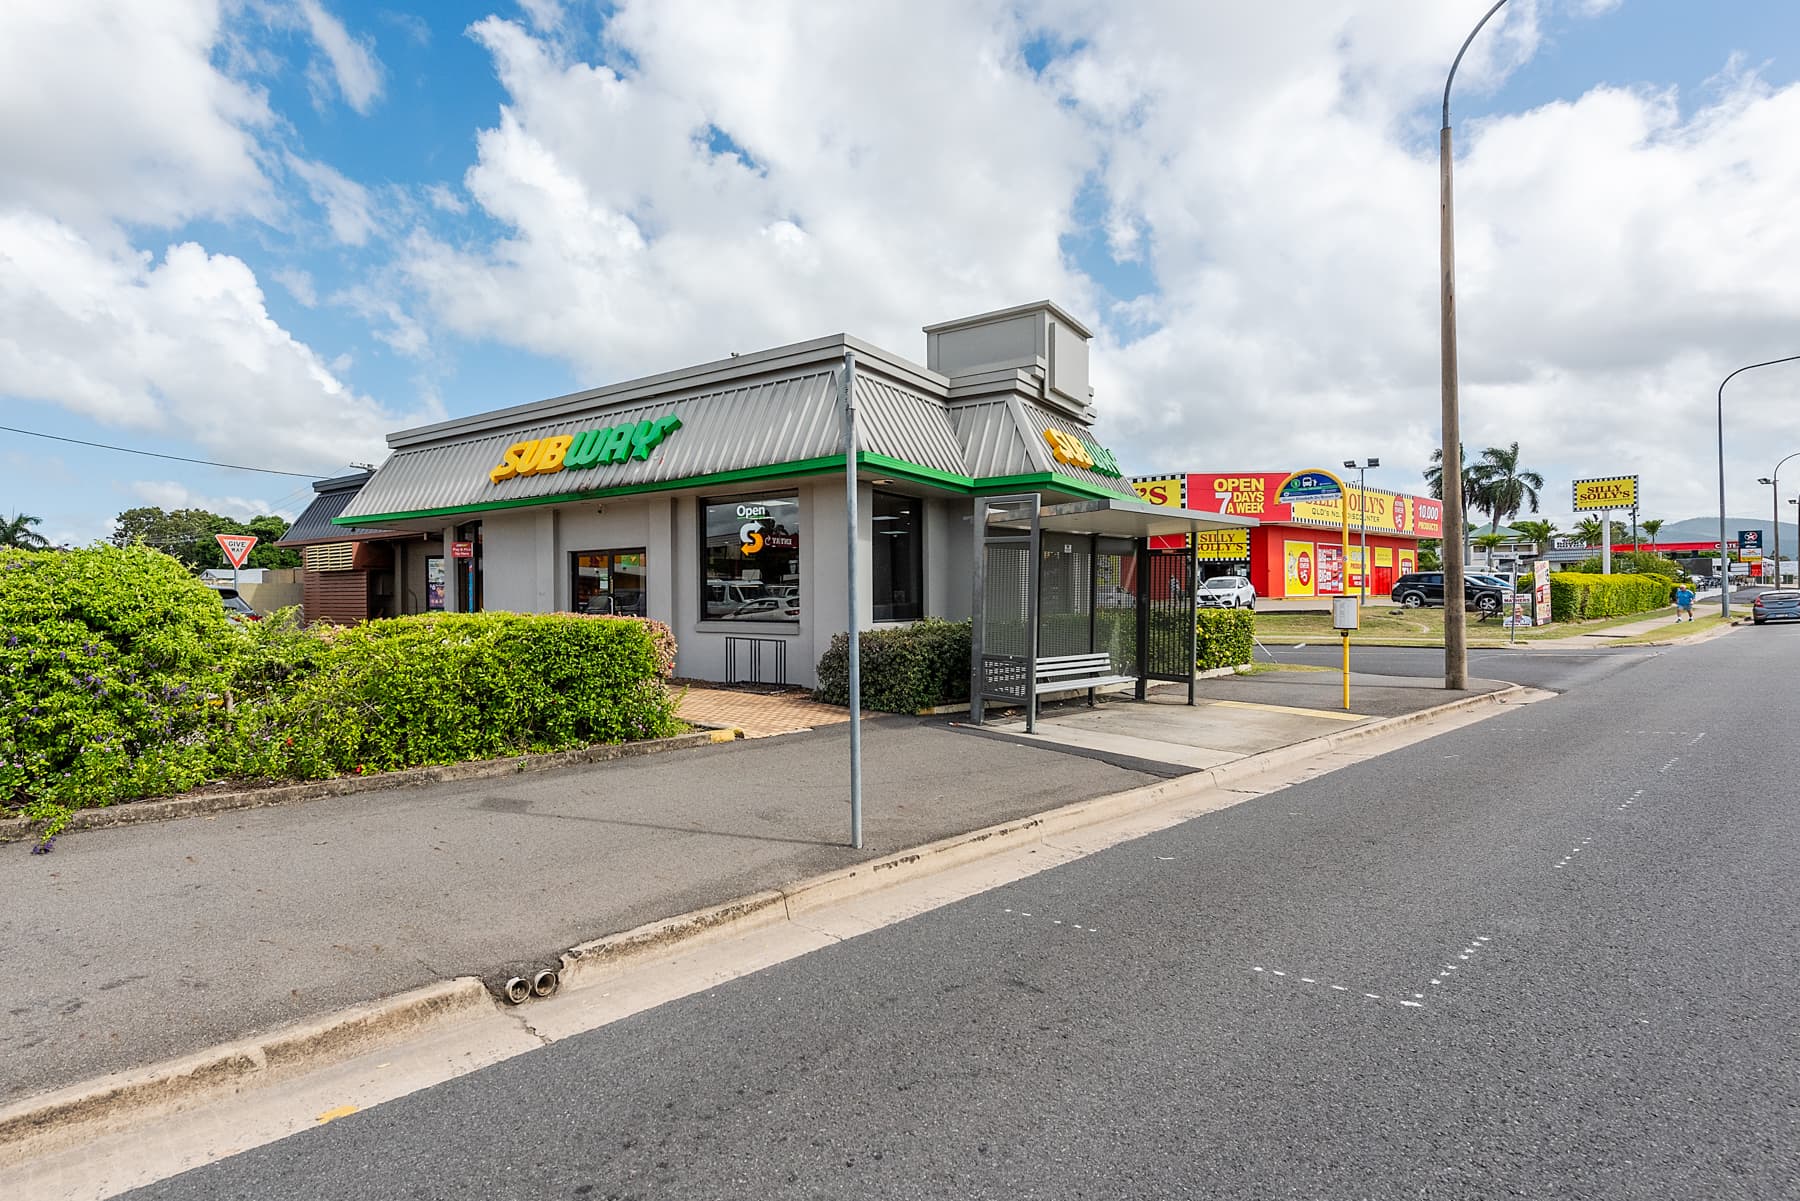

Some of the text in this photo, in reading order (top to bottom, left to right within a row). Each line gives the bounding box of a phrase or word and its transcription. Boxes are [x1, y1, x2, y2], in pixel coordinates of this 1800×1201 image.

[489, 412, 683, 484] SUBWAY
[1043, 427, 1122, 480] SUBWAY
[1213, 478, 1265, 492] OPEN
[1587, 484, 1622, 494] SILLY
[1579, 490, 1630, 501] SOLLY'S
[1215, 492, 1264, 514] 7 DAYS
[1227, 502, 1264, 514] A WEEK
[1349, 493, 1385, 515] OLLY'S
[736, 505, 765, 519] Open
[1418, 503, 1439, 521] 10,000
[1200, 533, 1235, 543] SILLY
